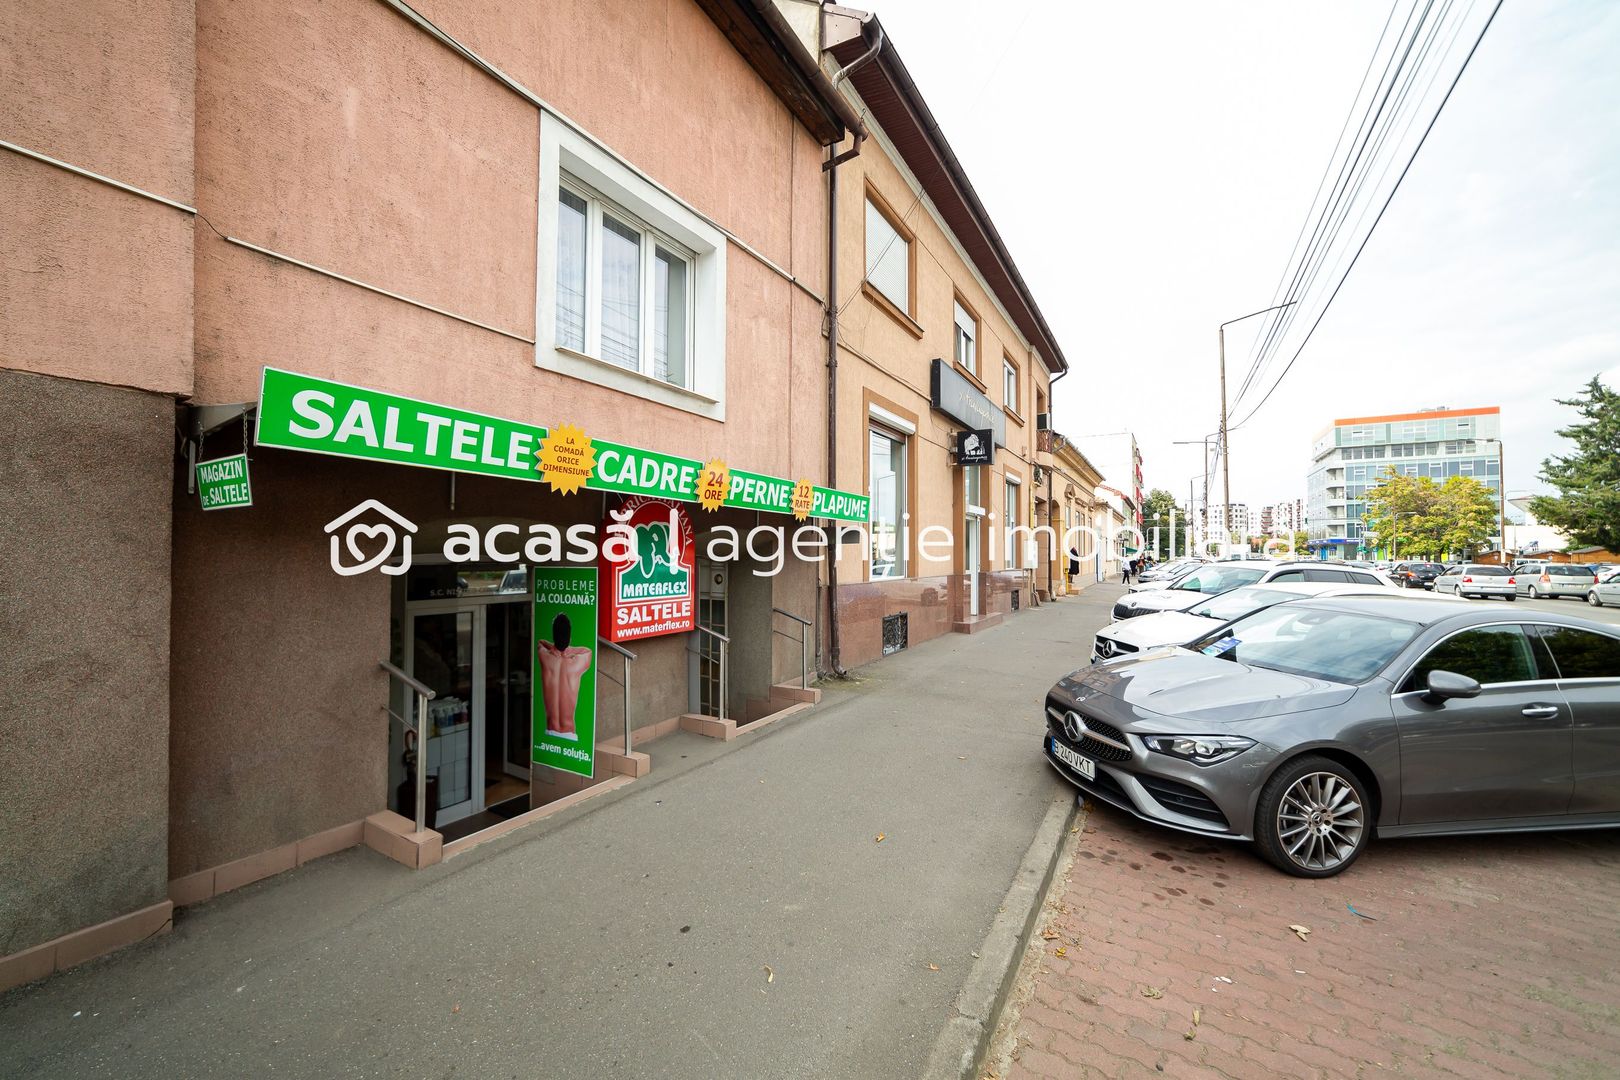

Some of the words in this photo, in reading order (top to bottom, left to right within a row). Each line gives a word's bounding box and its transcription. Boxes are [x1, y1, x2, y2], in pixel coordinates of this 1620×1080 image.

[566, 437, 575, 445] LA
[288, 389, 534, 470] SALTELE
[597, 450, 697, 494] CADRE
[729, 475, 790, 508] PERNE
[812, 491, 867, 518] PLAPUME
[553, 445, 585, 456] COMADĂ
[556, 456, 580, 466] ORICE
[200, 460, 243, 484] MAGAZIN
[543, 463, 590, 477] DIMENSIUNE
[707, 471, 724, 487] 24
[202, 495, 209, 506] DE
[209, 483, 249, 504] SALTELE
[704, 489, 723, 501] ORE
[798, 485, 810, 498] 12
[795, 499, 810, 509] RATE
[536, 579, 595, 591] PROBLEME
[623, 581, 687, 597] MATERFLEX
[536, 593, 546, 603] LA
[548, 592, 595, 605] COLOANĂ?
[617, 602, 691, 625] SALTELE
[617, 620, 690, 638] www.materflex.ro
[1073, 753, 1091, 774] VKT
